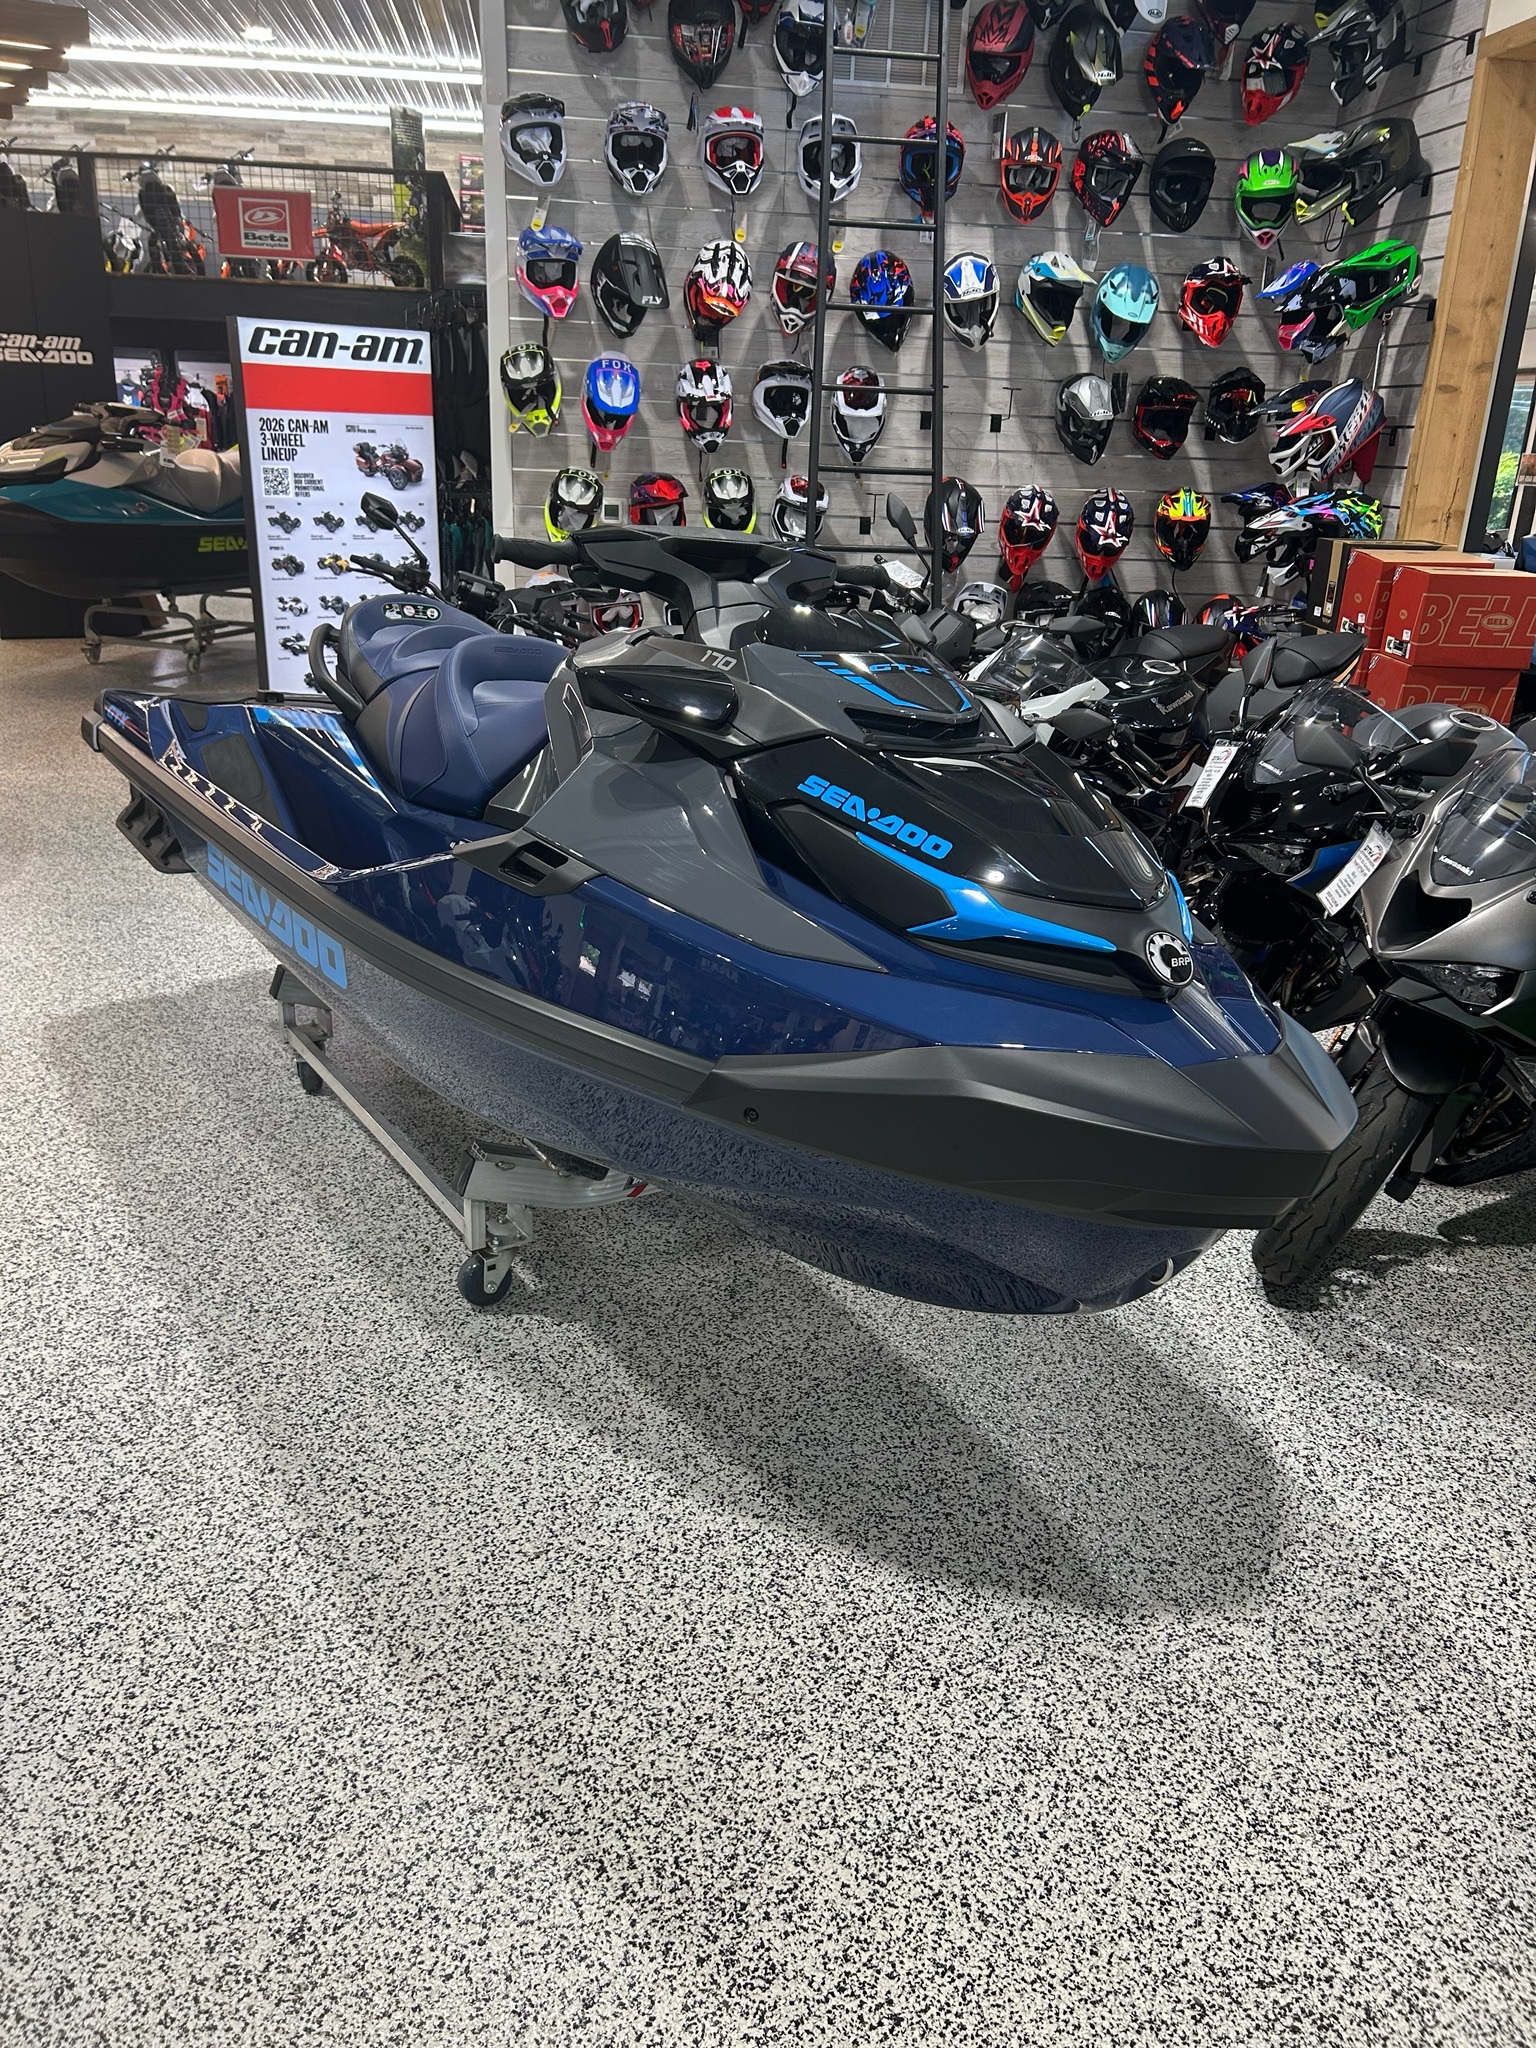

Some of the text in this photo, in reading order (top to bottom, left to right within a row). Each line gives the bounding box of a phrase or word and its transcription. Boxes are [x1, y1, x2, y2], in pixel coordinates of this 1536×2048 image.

[244, 232, 289, 242] Beta
[642, 296, 663, 304] FLY
[508, 343, 538, 355] FOX
[602, 359, 632, 373] FOX
[259, 417, 285, 432] 2026
[288, 418, 329, 434] CAN-AM
[260, 432, 306, 447] 3-WHEEL
[261, 446, 298, 461] LINEUP
[568, 467, 597, 483] FOX
[713, 469, 742, 477] FOX
[1410, 593, 1536, 649] BELL
[1486, 617, 1509, 626] BELL
[700, 649, 737, 672] 170
[869, 663, 933, 675] GTX
[1160, 690, 1194, 715] Kawasaki
[1439, 854, 1474, 877] Kawasaki
[1171, 957, 1190, 967] BRP
